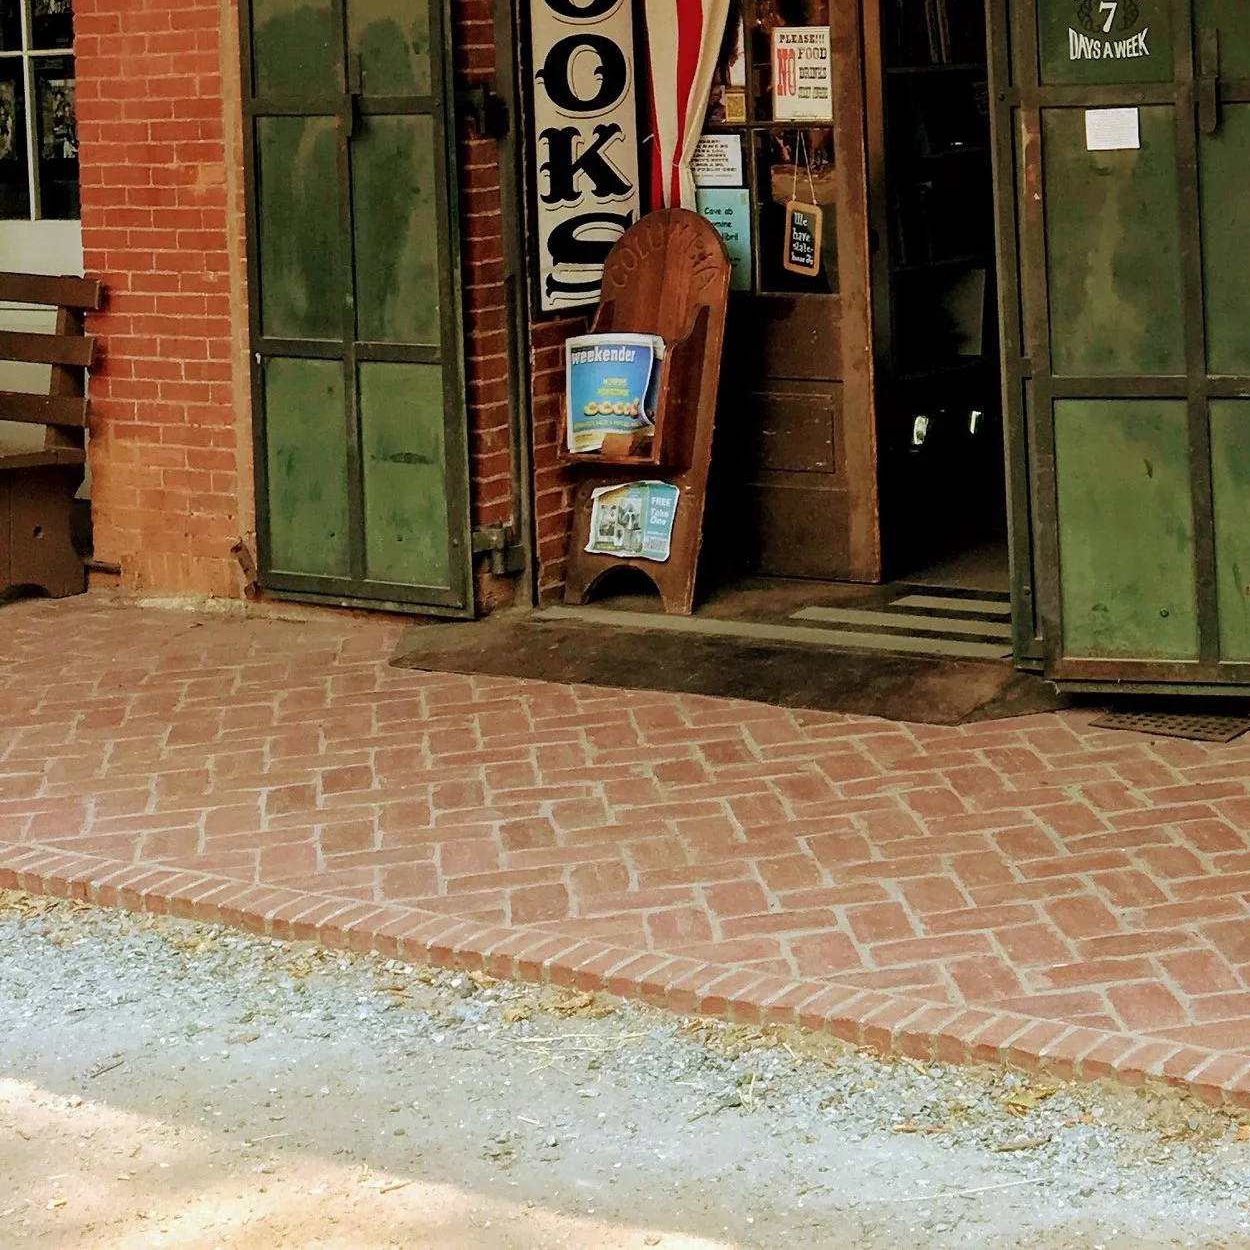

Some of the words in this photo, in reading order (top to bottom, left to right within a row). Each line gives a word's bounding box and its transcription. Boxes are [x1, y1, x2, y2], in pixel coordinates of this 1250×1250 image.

[1099, 1, 1117, 33] 7
[779, 34, 825, 44] PLEASE!!!
[1068, 27, 1101, 60] DAYS
[1103, 41, 1114, 59] A
[1114, 28, 1150, 59] WEEK
[777, 48, 796, 96] NO
[798, 47, 827, 60] FOOD
[794, 211, 807, 226] We
[792, 226, 811, 242] have
[572, 346, 636, 365] weekender
[651, 496, 672, 507] FREE
[651, 508, 669, 518] Take
[650, 516, 667, 526] One
